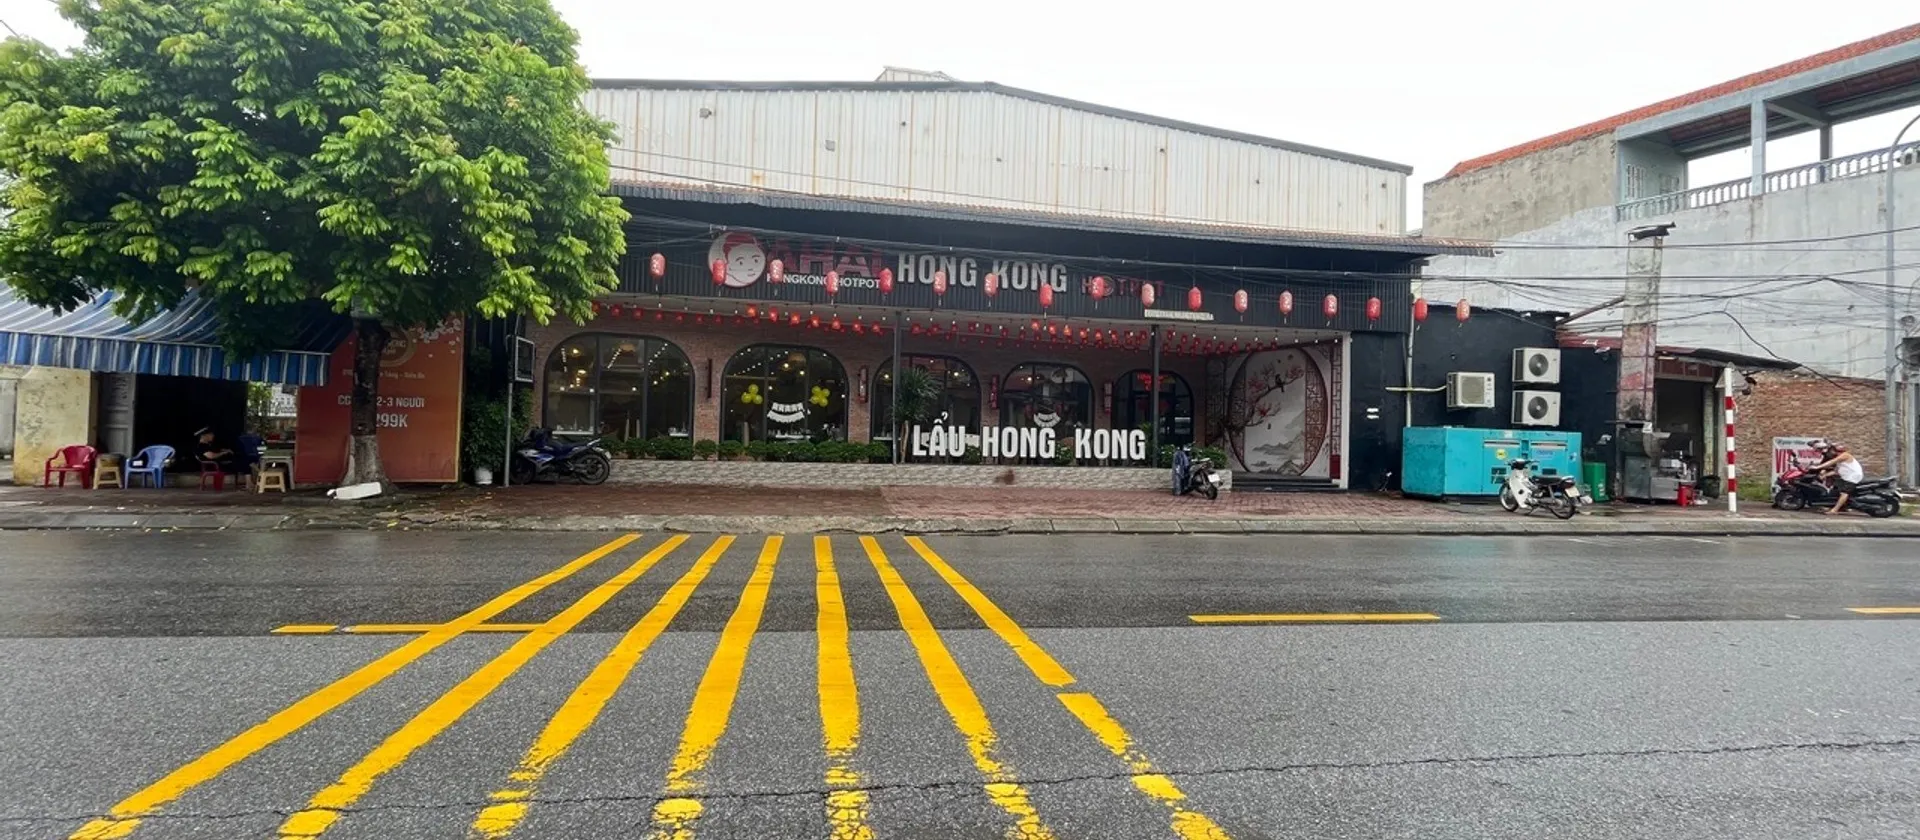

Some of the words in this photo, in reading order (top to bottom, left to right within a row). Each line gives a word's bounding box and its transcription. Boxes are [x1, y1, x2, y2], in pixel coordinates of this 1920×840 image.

[897, 252, 977, 288] HONG
[990, 259, 1068, 293] KONG
[912, 411, 966, 456] LẨU
[982, 426, 1056, 459] HONG
[1075, 428, 1146, 460] KONG
